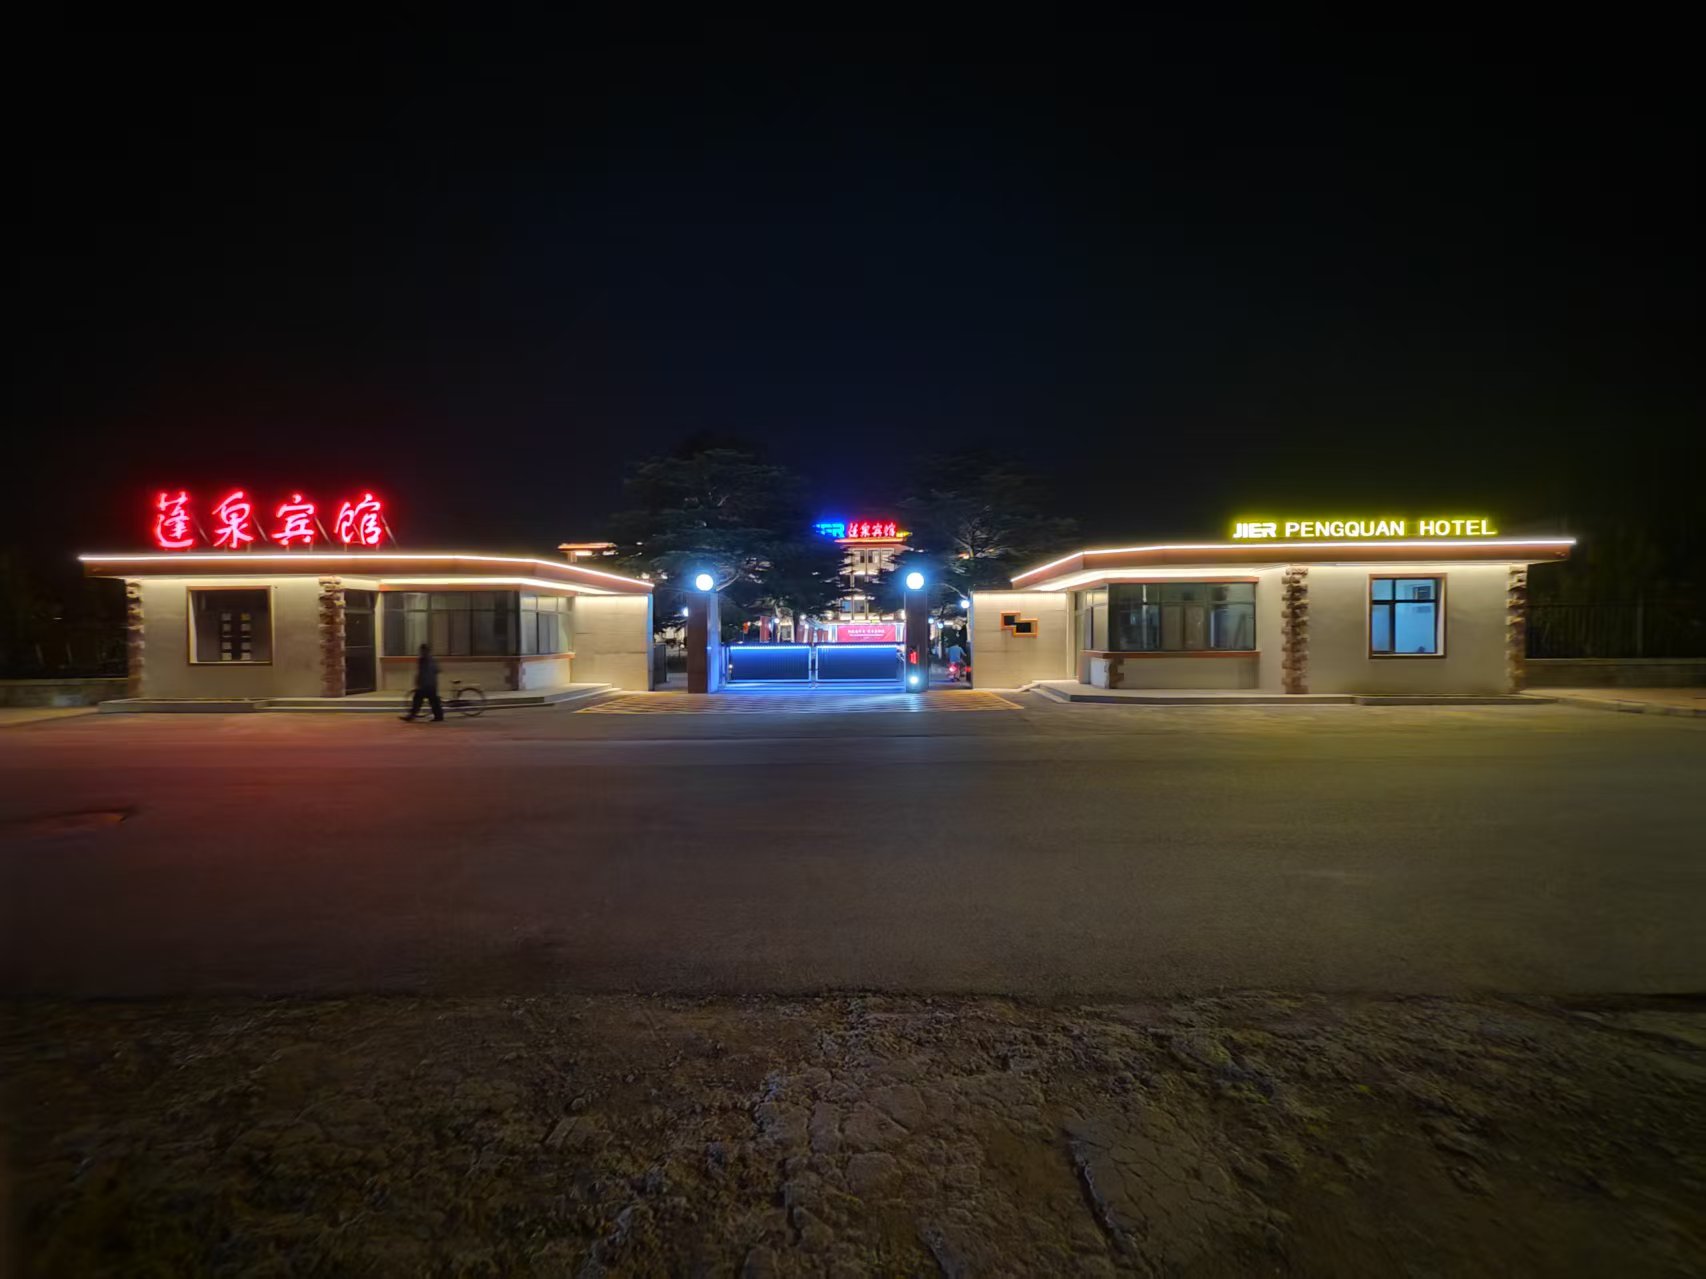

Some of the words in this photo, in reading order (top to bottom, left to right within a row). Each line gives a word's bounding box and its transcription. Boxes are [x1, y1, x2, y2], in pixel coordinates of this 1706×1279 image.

[154, 490, 384, 549] 蓬泉宾馆
[1232, 522, 1277, 539] JIER
[1284, 520, 1405, 538] PENGQUAN
[1419, 518, 1498, 537] HOTEL
